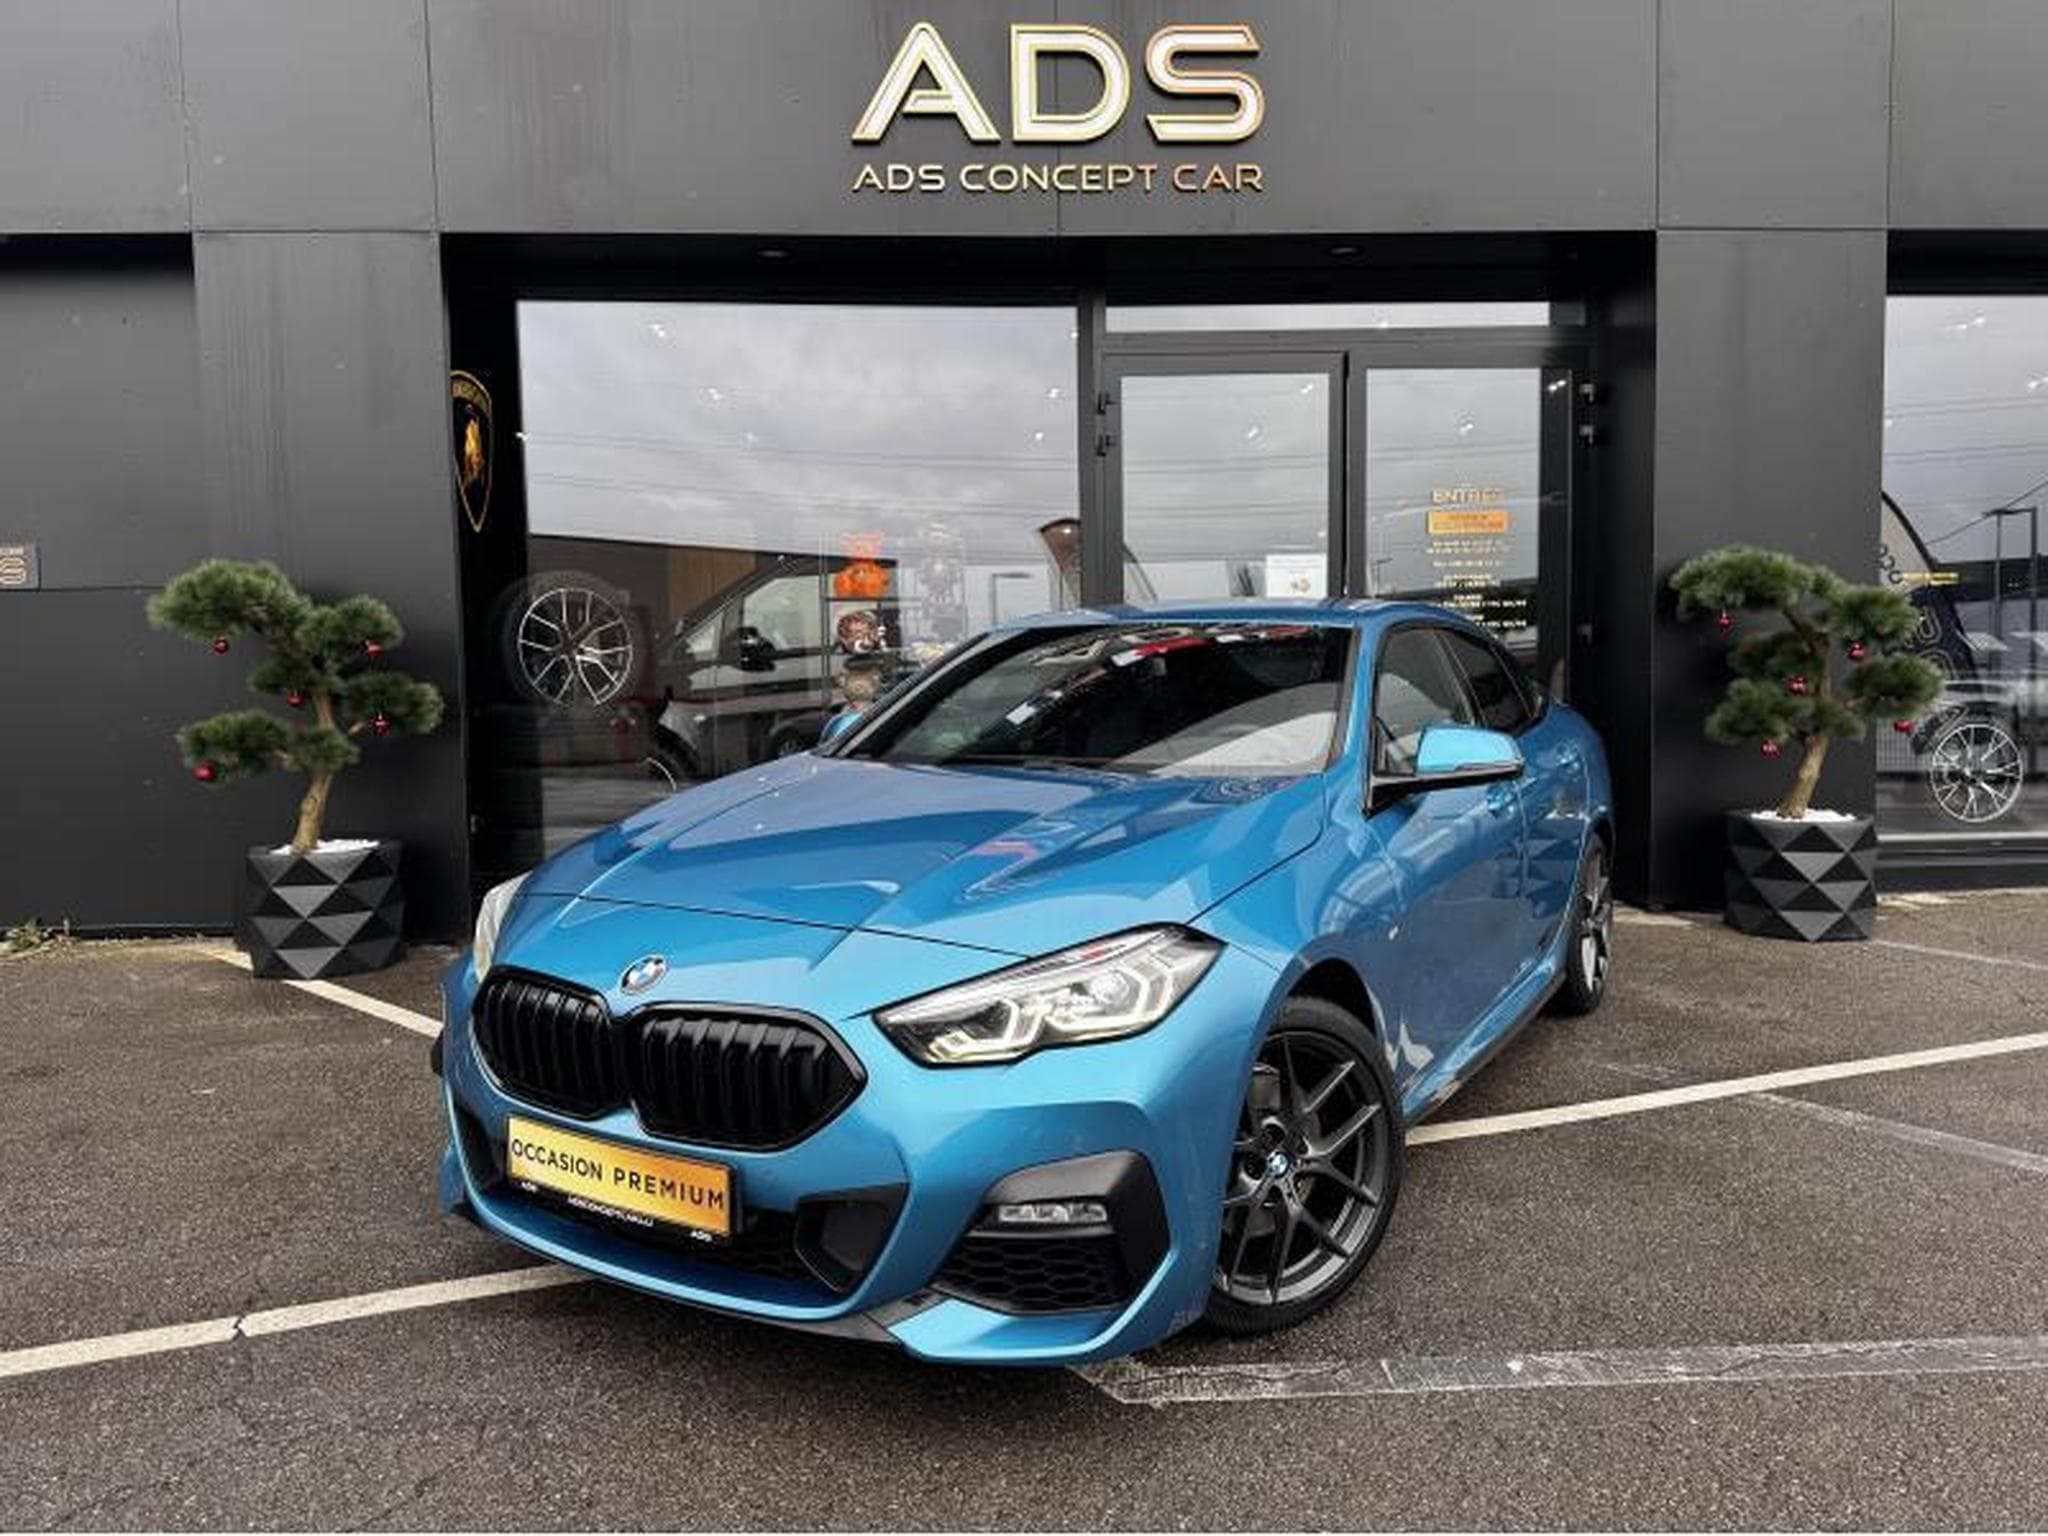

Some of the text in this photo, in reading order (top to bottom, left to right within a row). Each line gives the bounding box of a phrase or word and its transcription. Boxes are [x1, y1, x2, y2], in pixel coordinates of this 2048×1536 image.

[852, 22, 1265, 142] ADS
[853, 164, 1264, 191] ADS CONCEPT CAR
[511, 1139, 724, 1210] OCCASION PREMIUM
